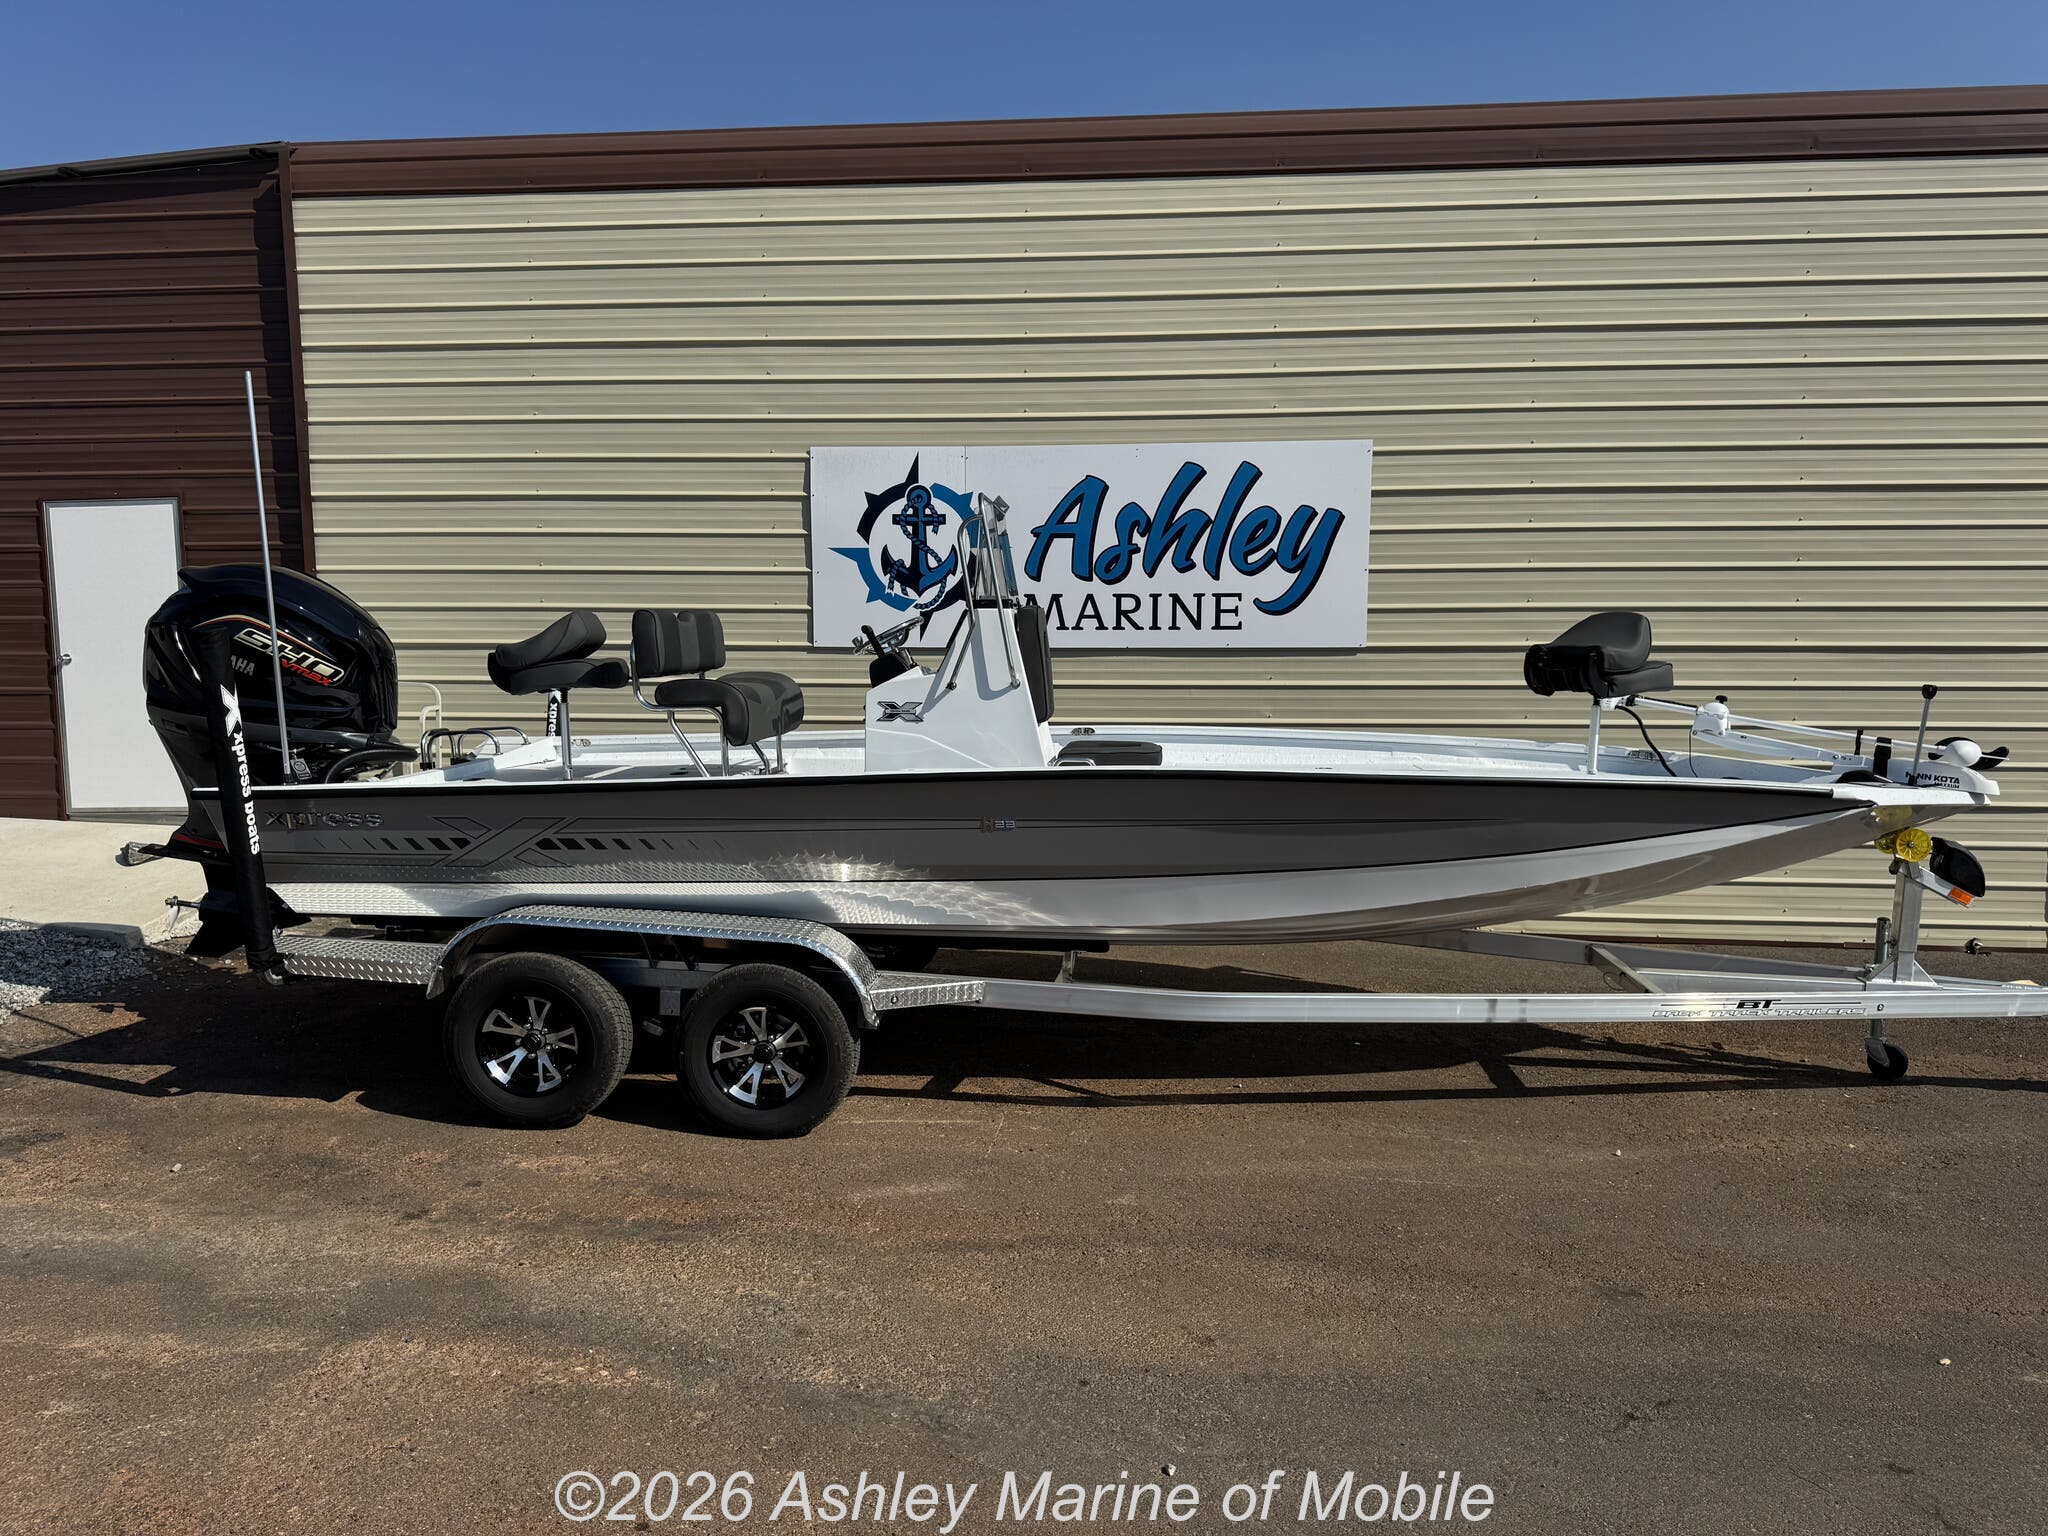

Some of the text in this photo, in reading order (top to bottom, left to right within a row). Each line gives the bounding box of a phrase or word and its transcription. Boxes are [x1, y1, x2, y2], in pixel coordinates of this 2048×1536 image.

[1024, 461, 1345, 616] Ashley
[1024, 593, 1243, 631] MARINE
[233, 627, 345, 686] SHO
[1933, 774, 1960, 784] KOTA
[264, 811, 384, 830] xpress
[1737, 999, 1781, 1009] BT
